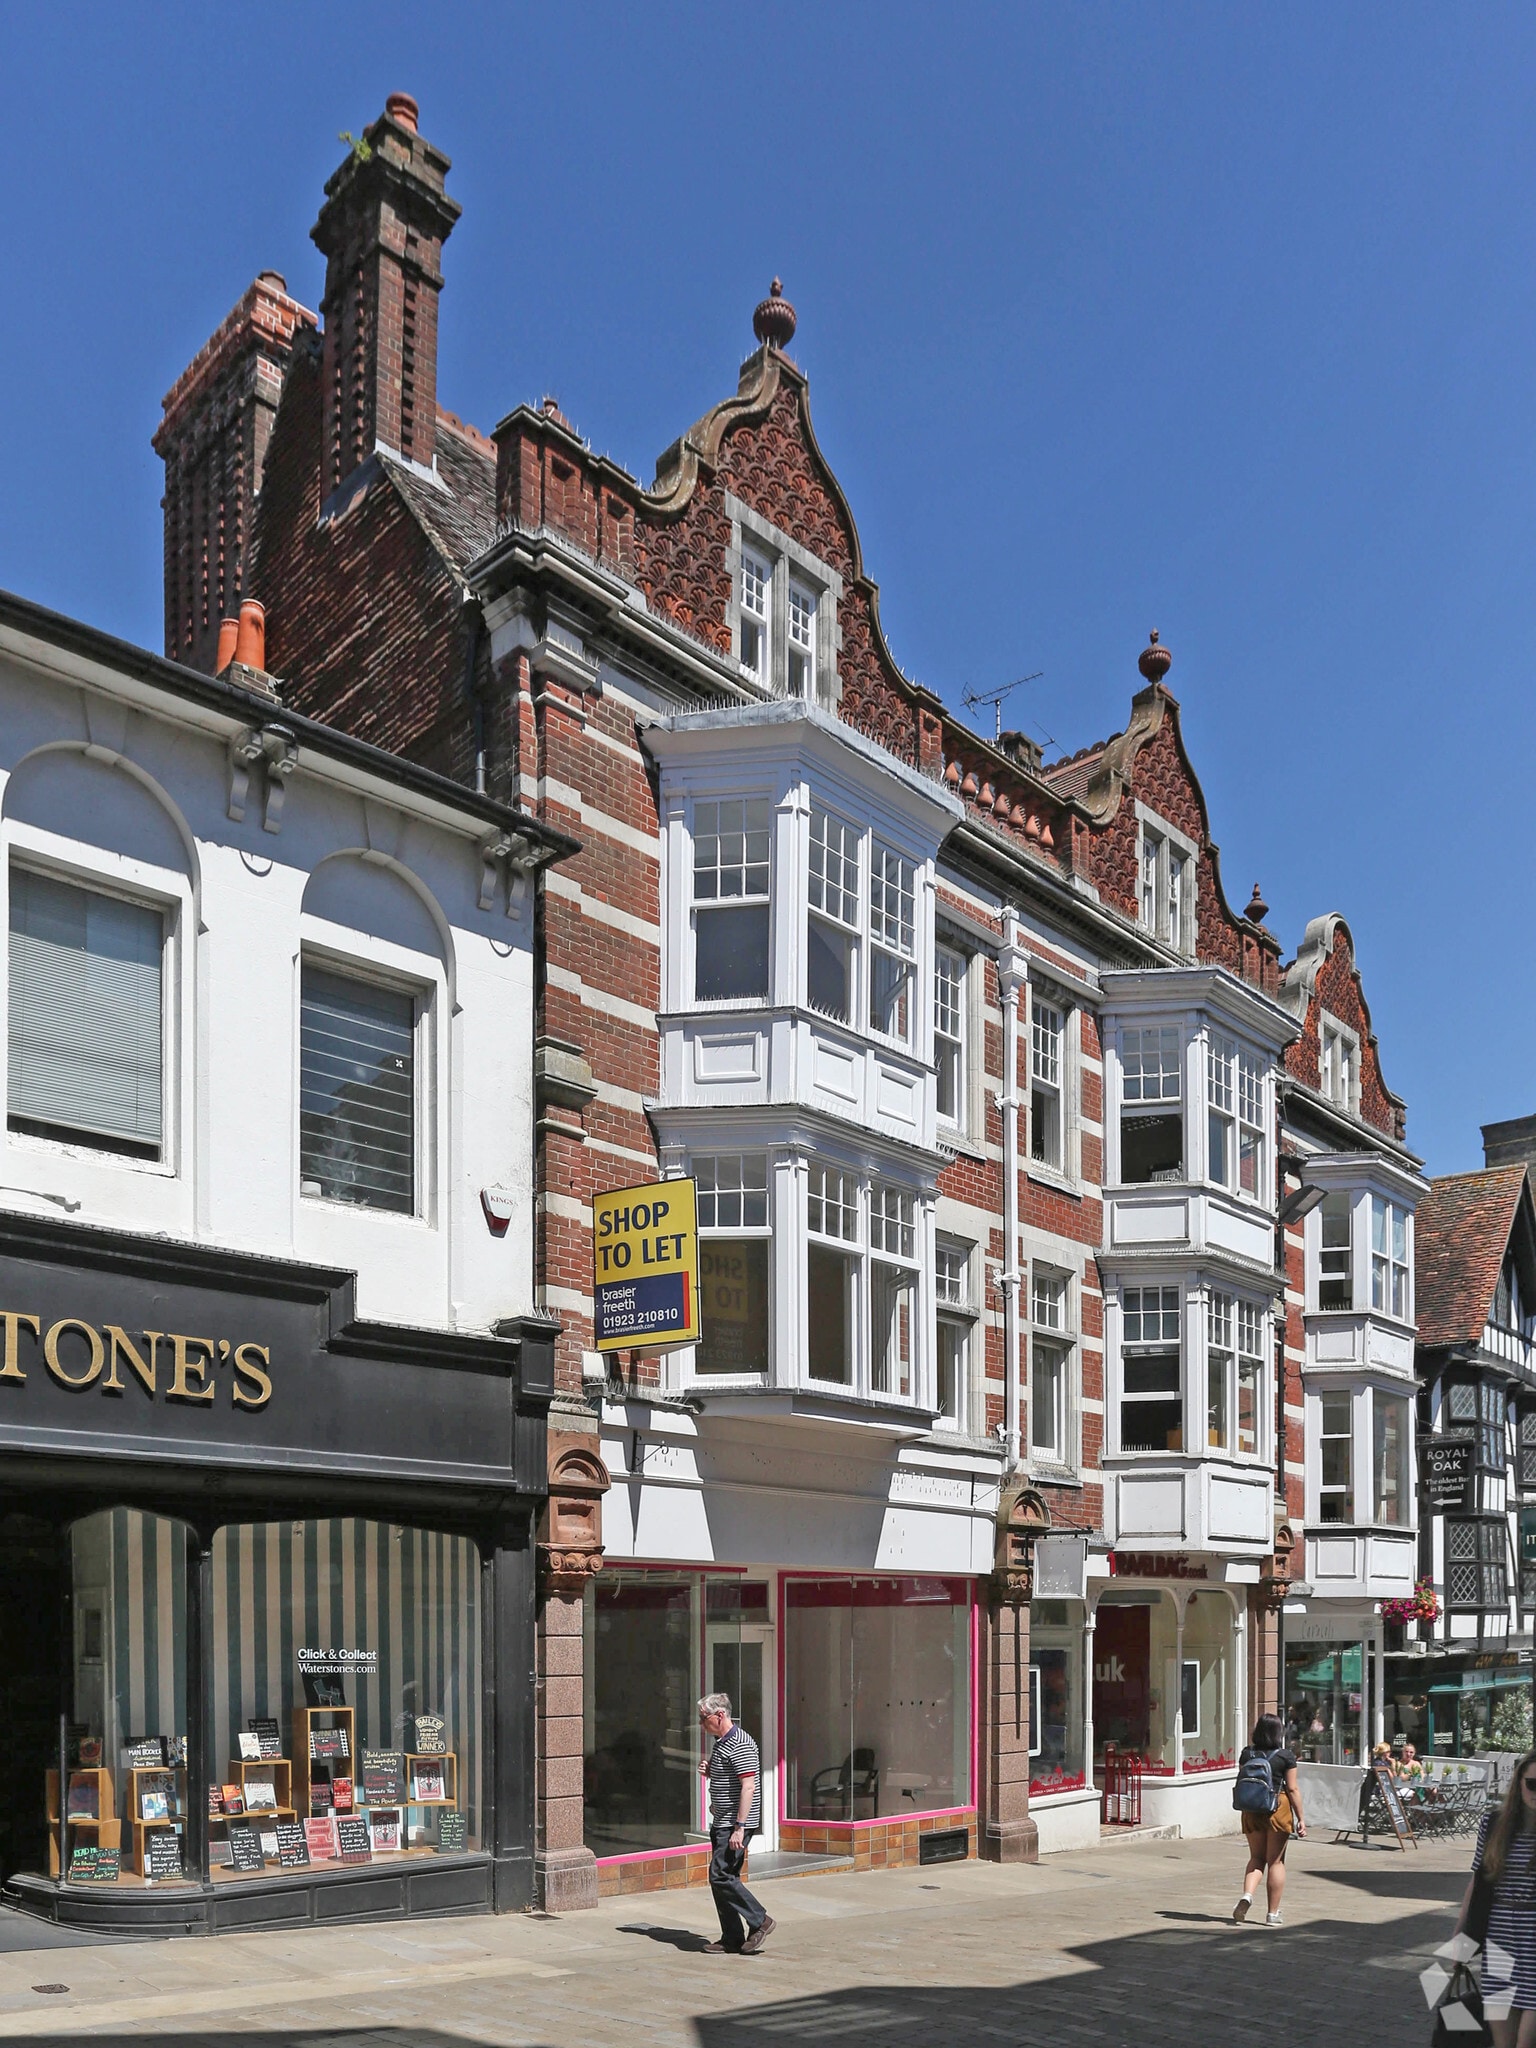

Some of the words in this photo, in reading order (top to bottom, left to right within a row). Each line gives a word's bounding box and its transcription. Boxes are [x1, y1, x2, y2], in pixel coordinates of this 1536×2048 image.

[598, 1200, 670, 1237] SHOP
[598, 1242, 632, 1271] TO
[642, 1233, 687, 1265] LET
[602, 1286, 637, 1301] brasier
[602, 1298, 636, 1314] freeth
[603, 1313, 635, 1329] 01923
[637, 1307, 678, 1324] 210810
[603, 1323, 656, 1335] www.brasierfreeth.com
[0, 1311, 273, 1406] TONE'S
[1426, 1448, 1468, 1461] ROYAL
[1432, 1460, 1462, 1472] OAK
[1438, 1484, 1464, 1493] England
[297, 1648, 327, 1660] Click
[328, 1649, 337, 1660] &
[338, 1649, 377, 1660] Collect
[298, 1662, 377, 1674] Waterstones.com
